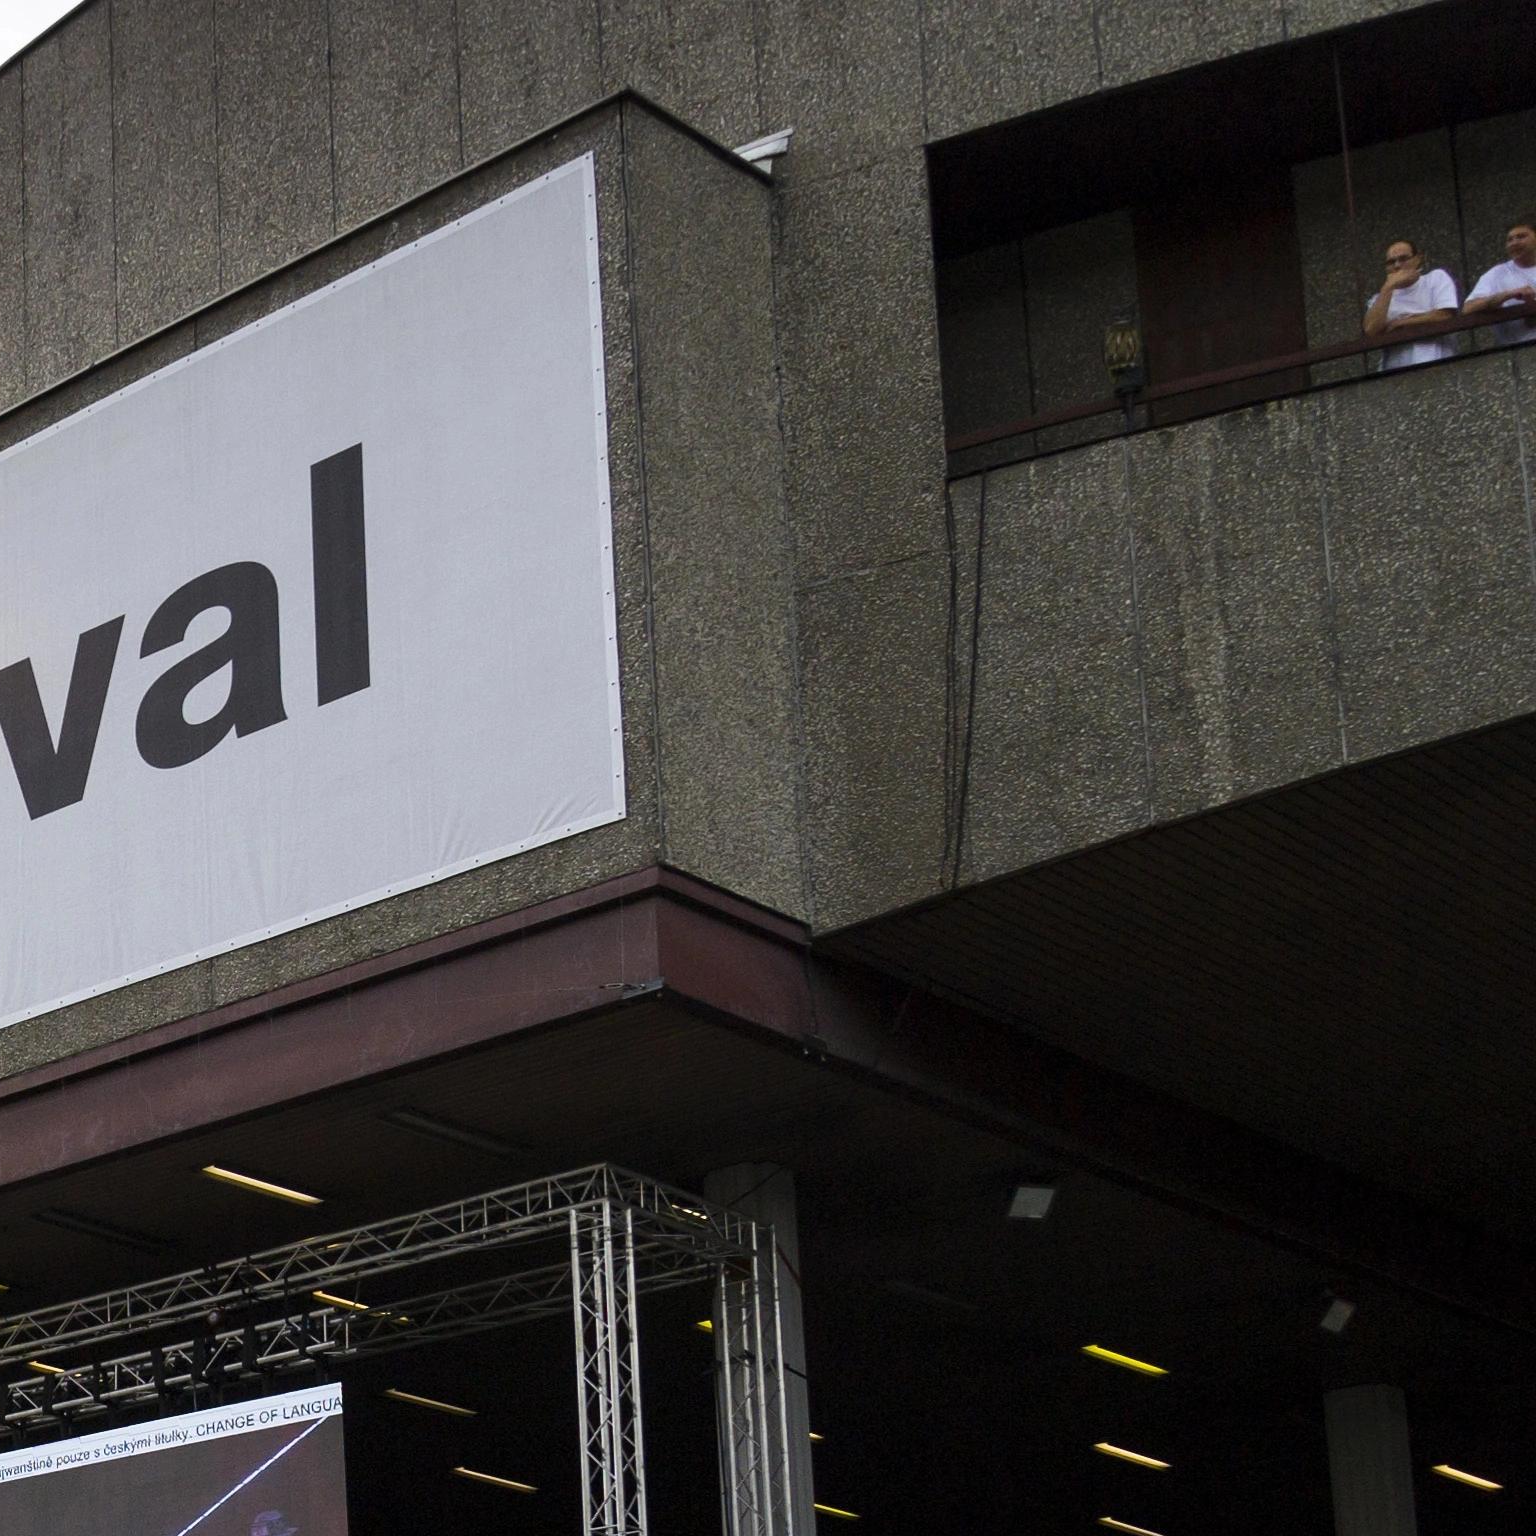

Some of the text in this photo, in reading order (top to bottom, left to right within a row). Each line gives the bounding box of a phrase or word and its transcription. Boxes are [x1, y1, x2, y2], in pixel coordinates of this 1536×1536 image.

[56, 1449, 91, 1468] pouze
[94, 1448, 101, 1459] s
[196, 1413, 255, 1437] CHANGE
[259, 1409, 278, 1424] OF
[282, 1396, 343, 1420] LANGUA
